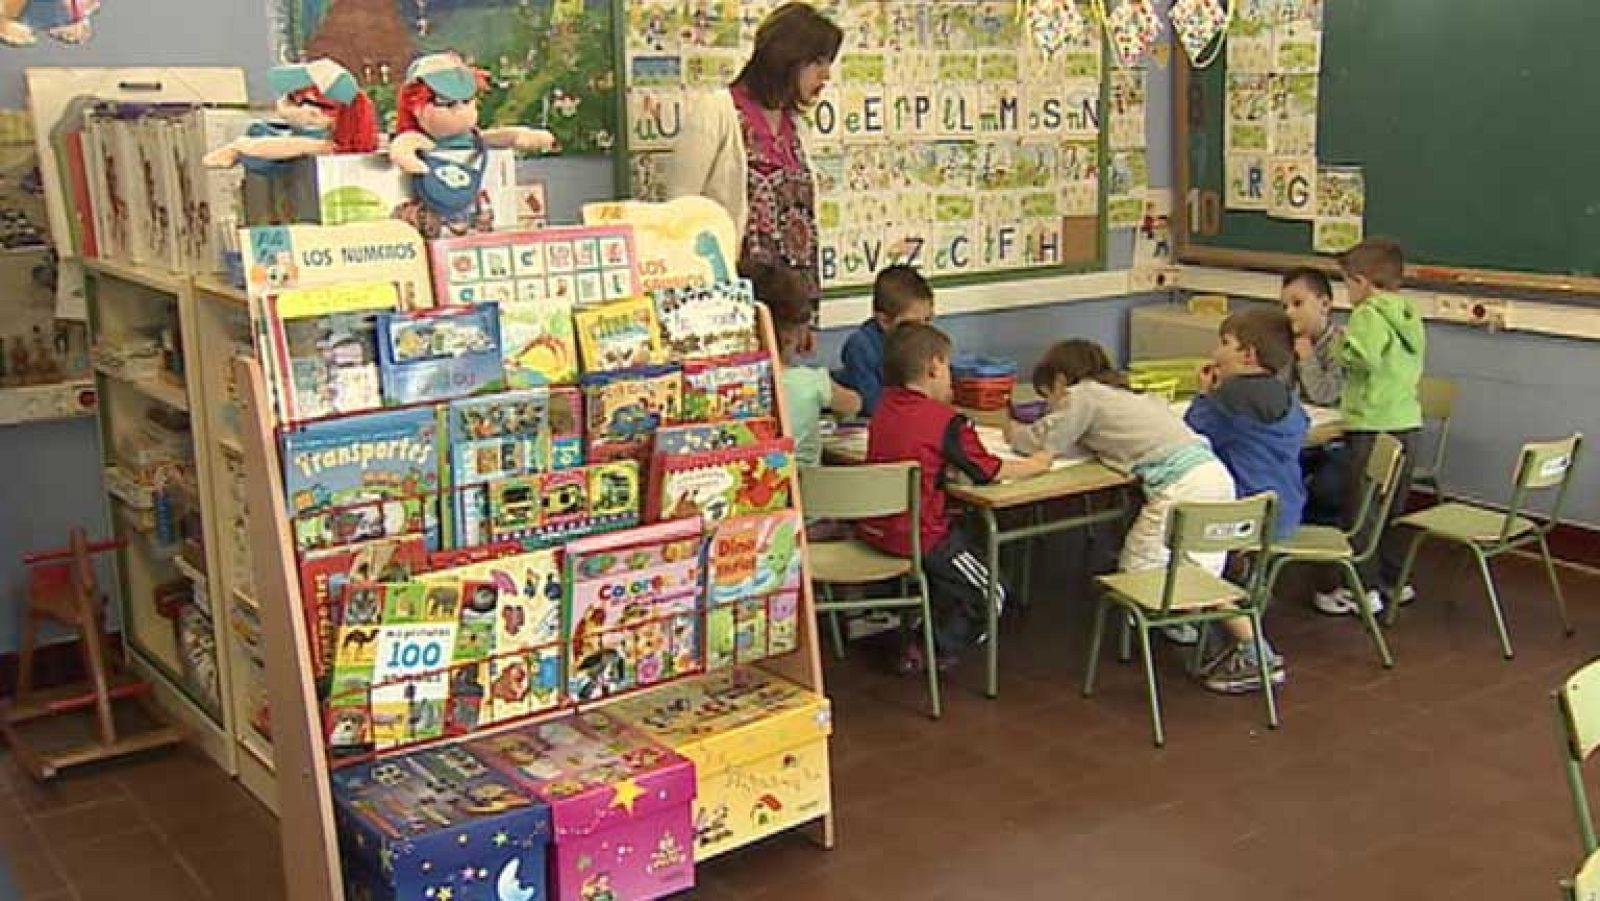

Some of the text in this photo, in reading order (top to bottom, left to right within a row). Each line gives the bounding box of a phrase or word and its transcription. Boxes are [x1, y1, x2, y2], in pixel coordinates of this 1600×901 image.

[303, 249, 332, 267] LOS
[639, 258, 667, 275] LOS
[294, 437, 432, 477] Transportes
[386, 641, 442, 669] 100
